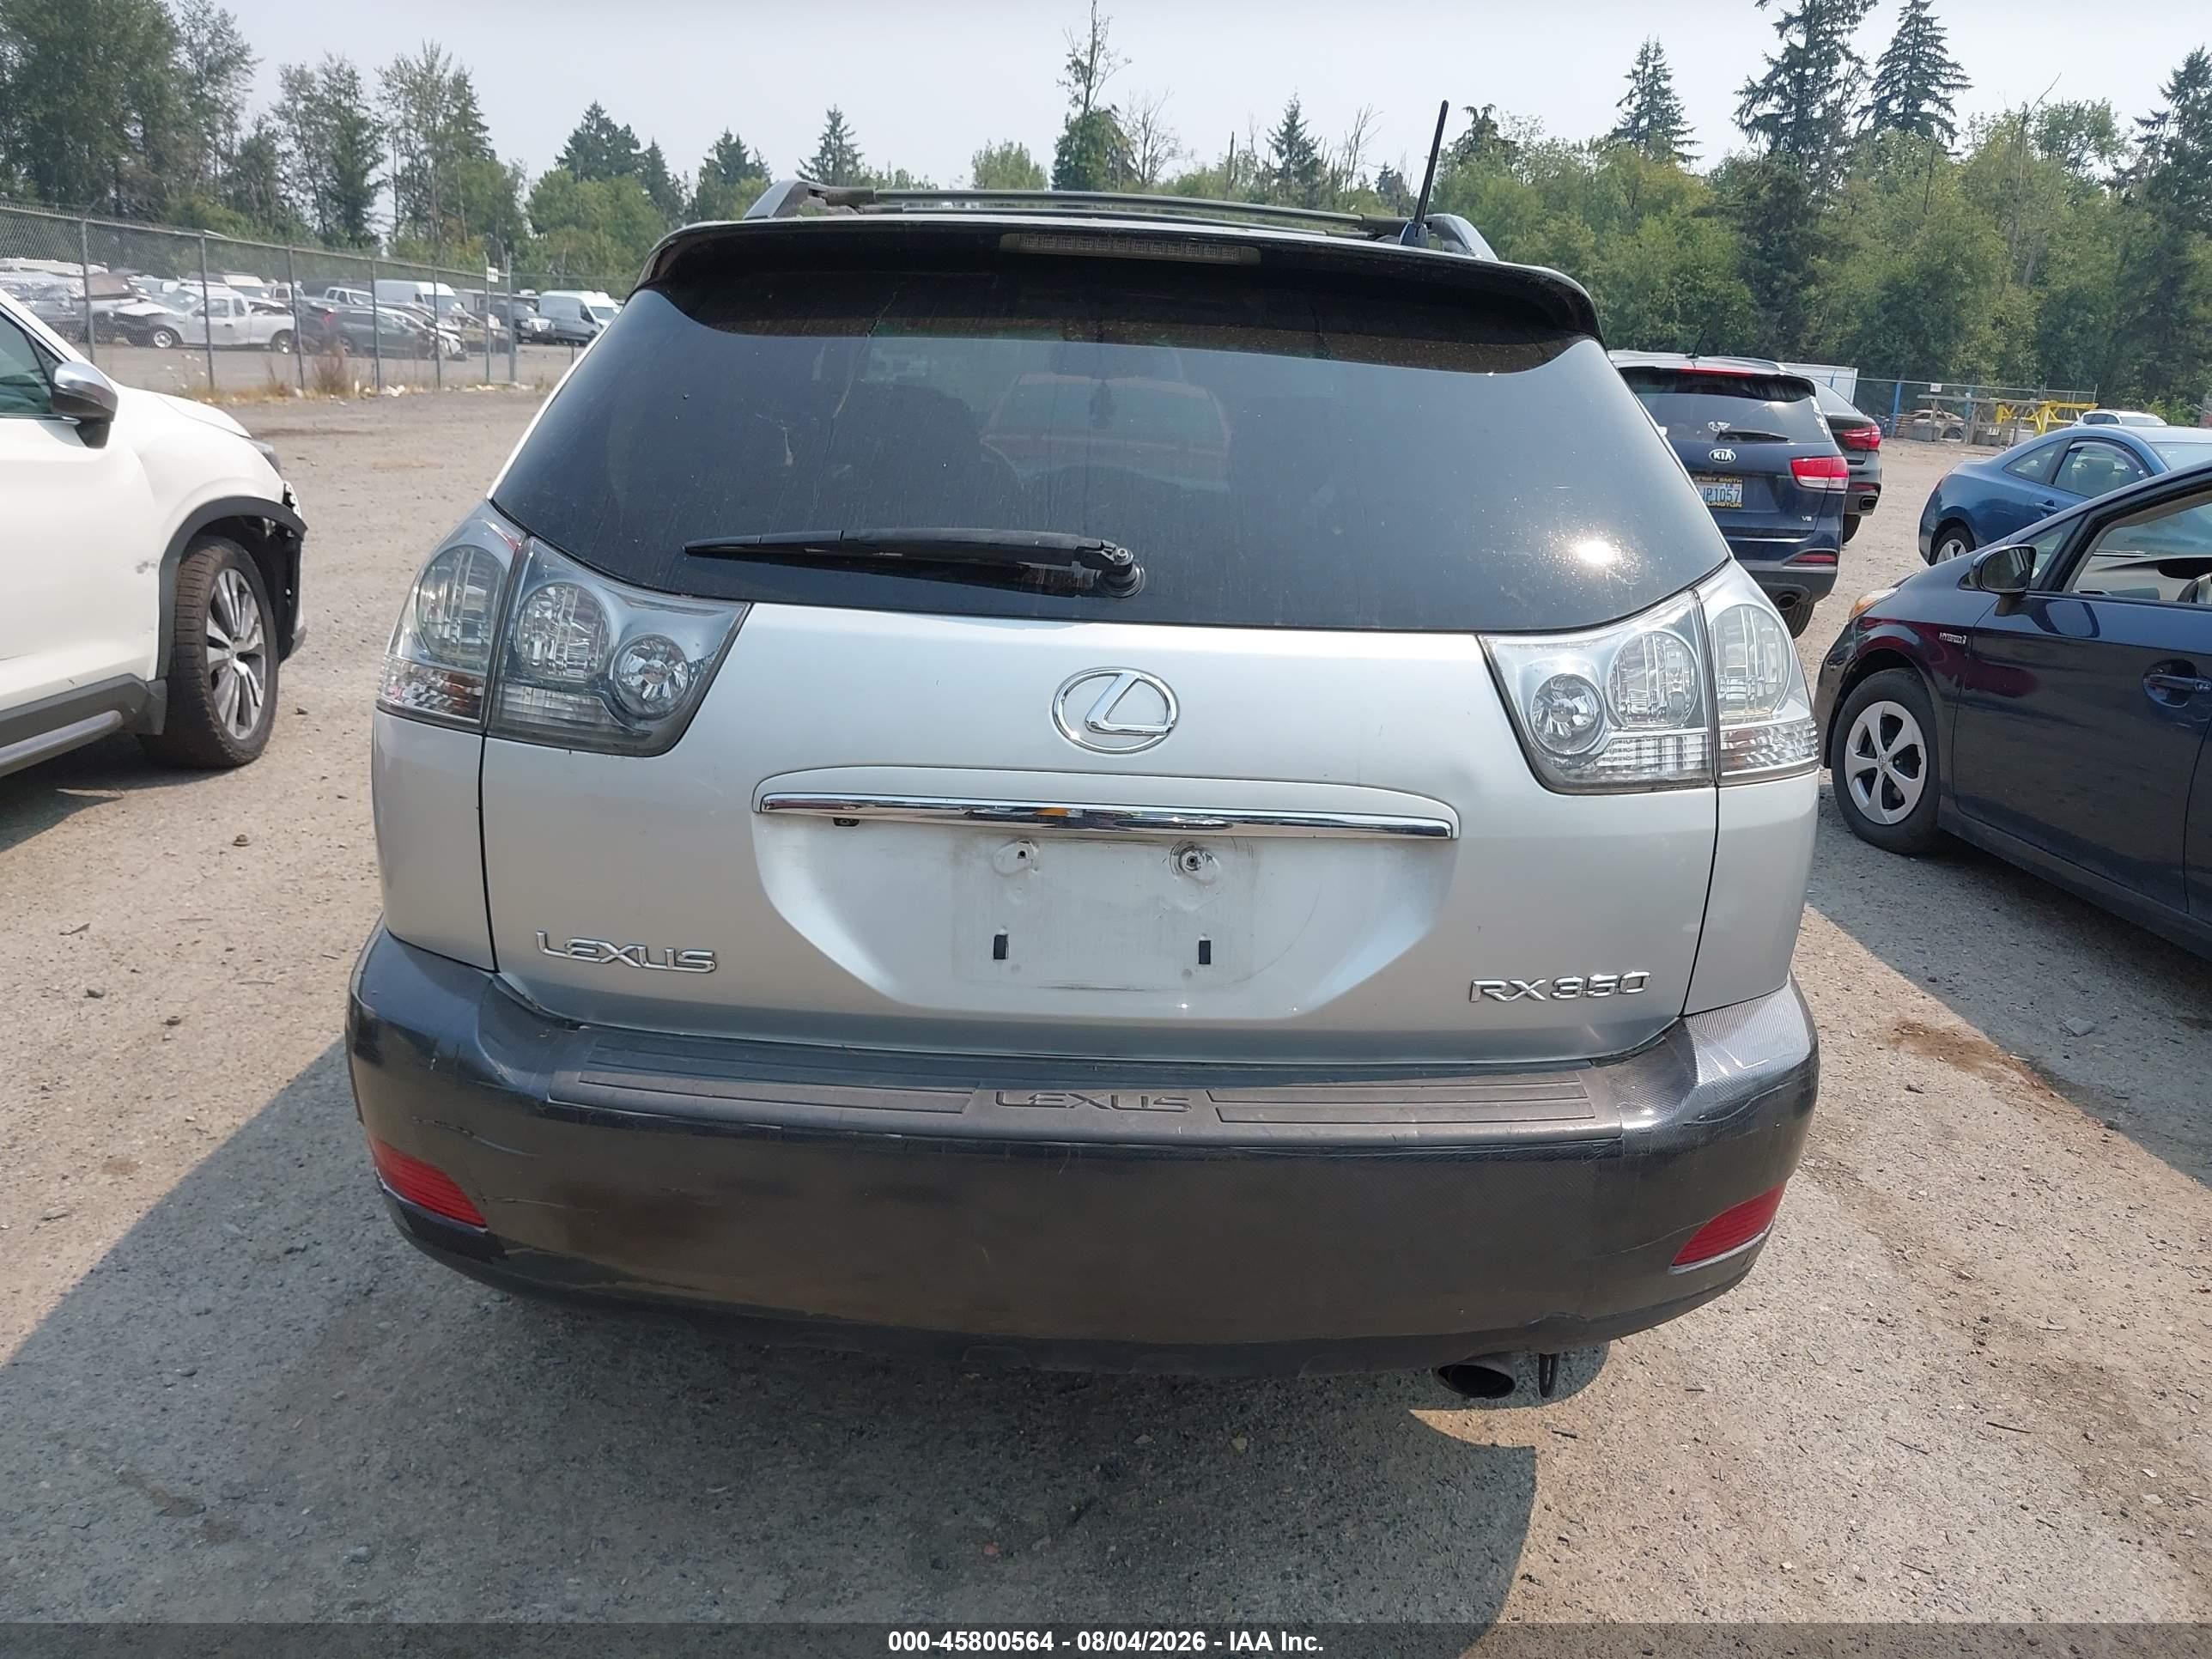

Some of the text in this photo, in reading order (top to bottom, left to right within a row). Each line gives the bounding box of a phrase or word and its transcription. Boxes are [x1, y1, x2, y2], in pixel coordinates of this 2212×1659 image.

[1712, 450, 1733, 461] KIA
[536, 931, 716, 973] LEXUS
[995, 1091, 1192, 1113] LEXUS
